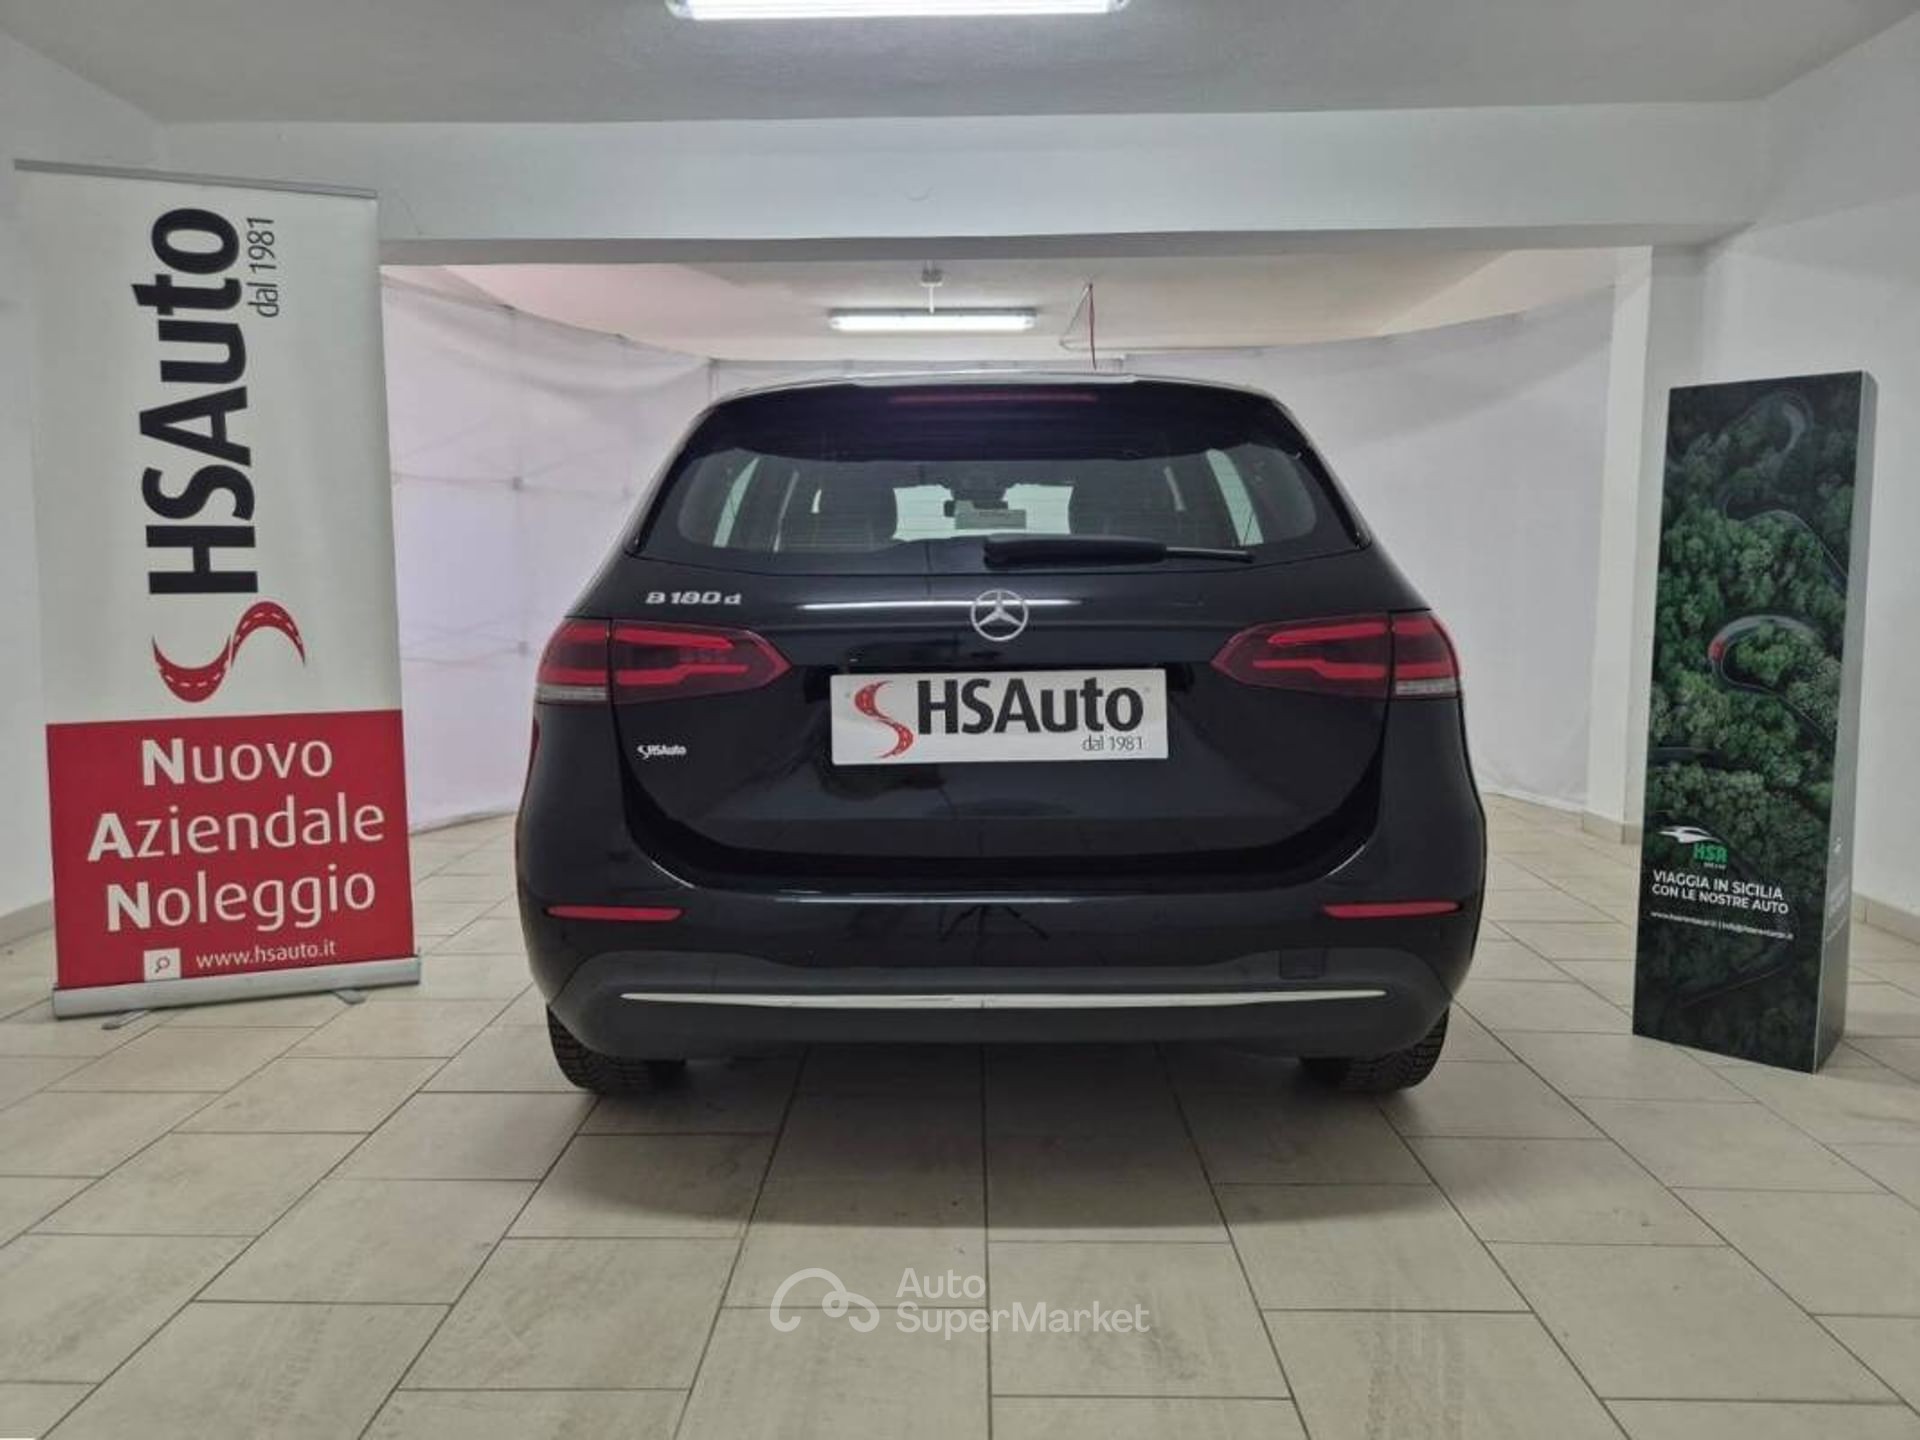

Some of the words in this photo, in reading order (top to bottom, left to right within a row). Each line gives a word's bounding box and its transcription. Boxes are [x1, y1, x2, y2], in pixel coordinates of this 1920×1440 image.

[247, 216, 277, 275] 1981
[247, 281, 280, 319] dal
[131, 208, 258, 594] HSAuto
[671, 591, 721, 605] 180
[723, 593, 742, 605] d
[917, 677, 1144, 735] HSAuto
[141, 738, 333, 786] Nuovo
[1082, 736, 1105, 752] dal
[1110, 736, 1143, 751] 1981
[87, 791, 385, 862] Aziendale
[106, 864, 376, 932] Noleggio
[1651, 884, 1679, 897] CON
[1681, 888, 1696, 901] LE
[1699, 891, 1749, 909] NOSTRE
[1751, 900, 1790, 915] AUTO
[1653, 869, 1710, 890] VIAGGIA
[1713, 879, 1729, 893] IN
[1732, 881, 1784, 900] SICILIA
[196, 940, 336, 969] www.hsauto.it
